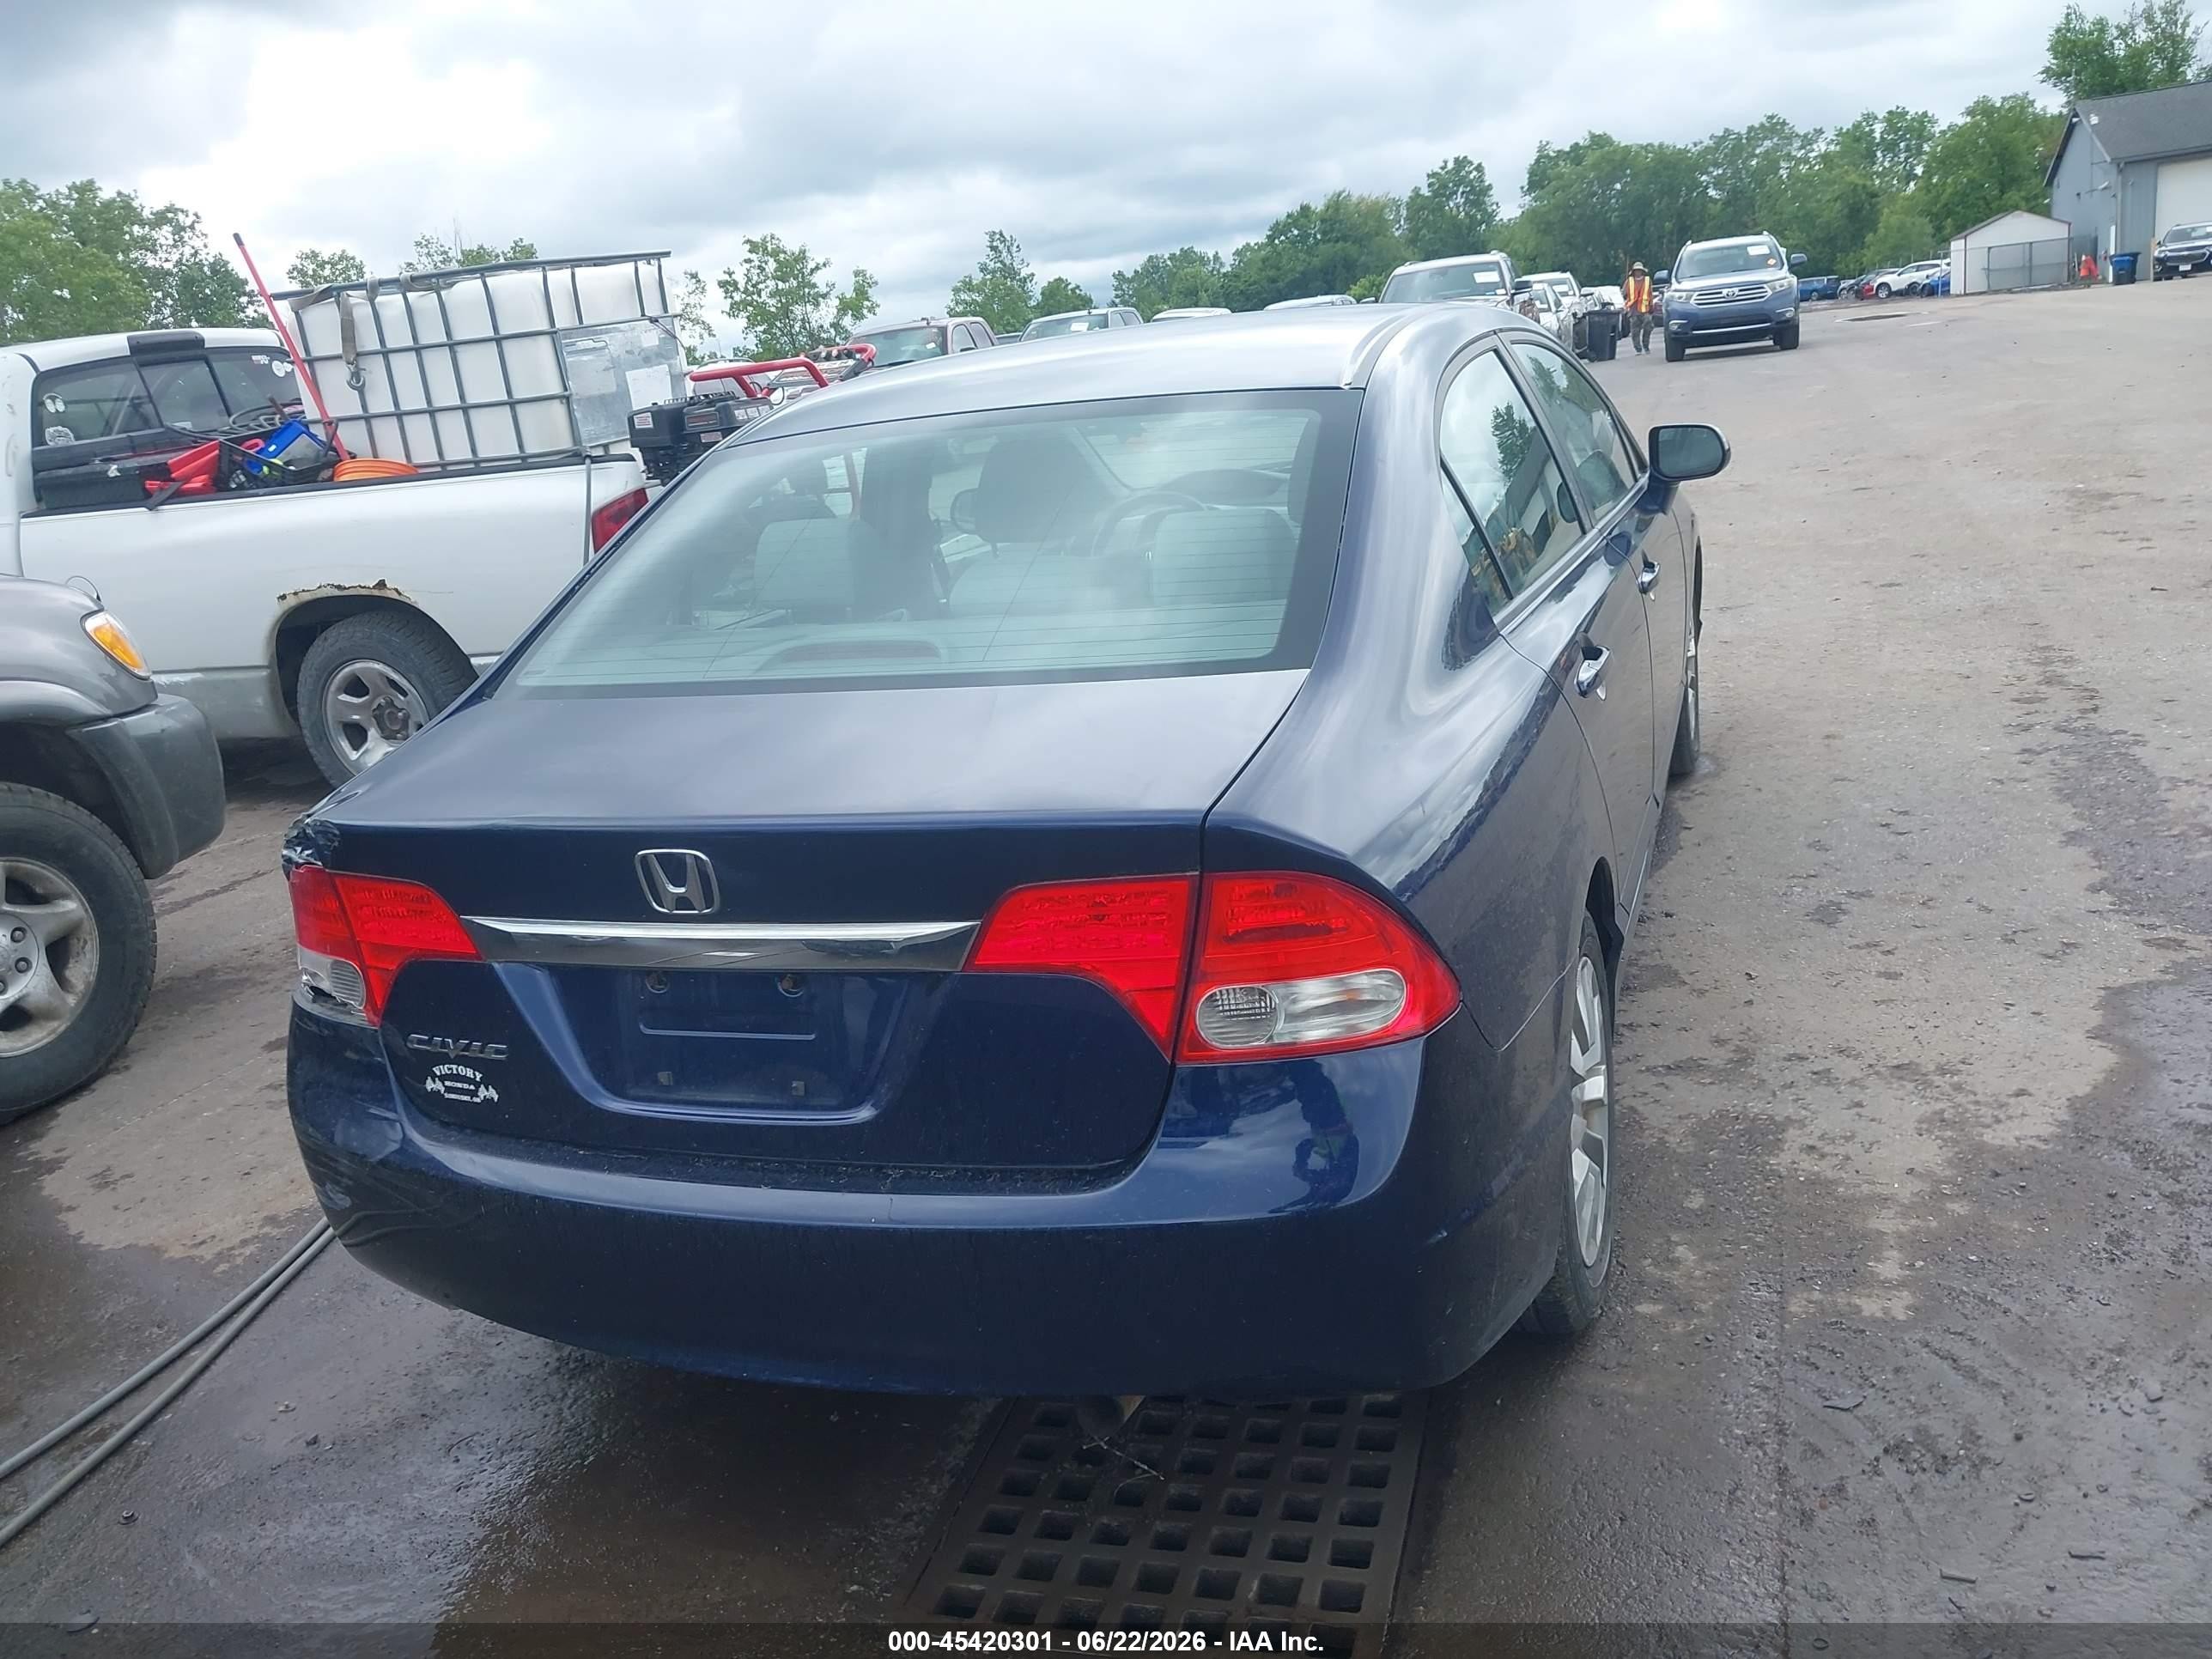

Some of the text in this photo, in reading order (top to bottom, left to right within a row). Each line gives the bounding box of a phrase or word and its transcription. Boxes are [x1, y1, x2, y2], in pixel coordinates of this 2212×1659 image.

[406, 1034, 508, 1060] CIVIC
[432, 1064, 483, 1082] VICTORY
[444, 1080, 476, 1090] HONDA
